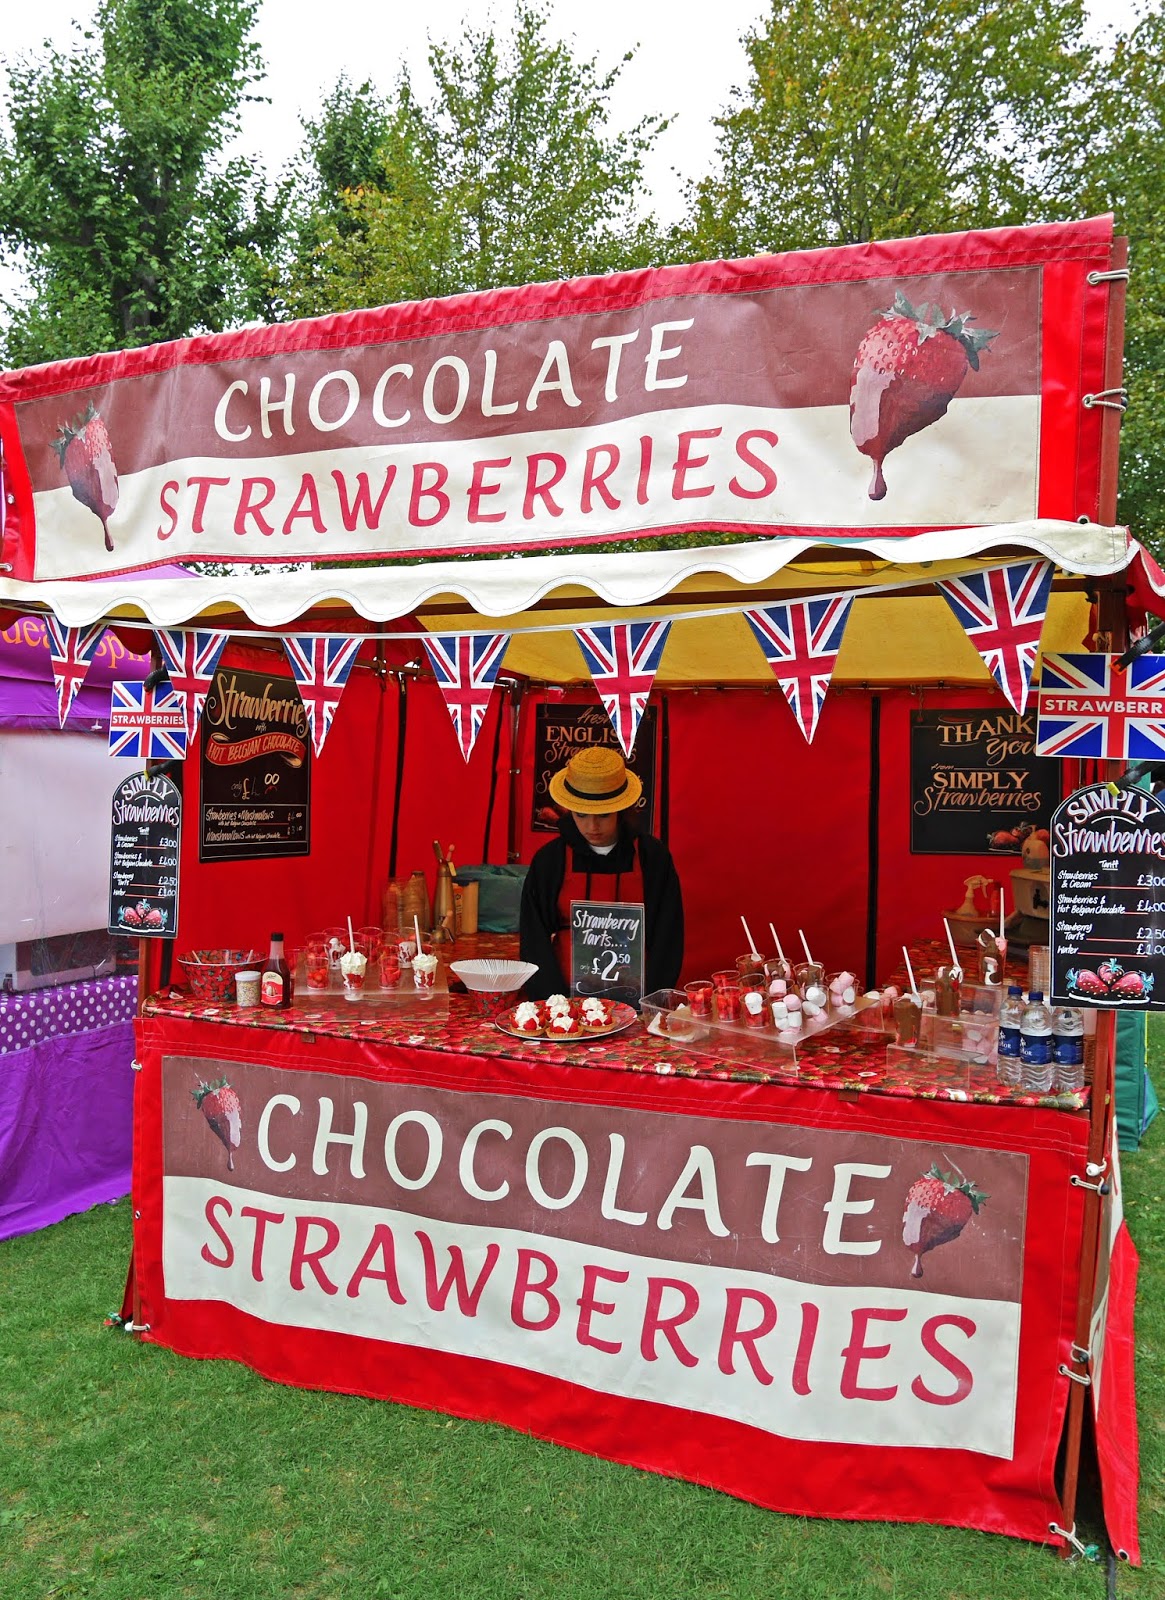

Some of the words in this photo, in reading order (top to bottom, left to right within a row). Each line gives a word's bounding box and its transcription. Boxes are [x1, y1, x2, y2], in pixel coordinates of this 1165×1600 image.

[213, 317, 695, 442] CHOCOLATE
[157, 426, 779, 541] STRAWBERRIES
[112, 715, 184, 725] STRAWBERRIES
[936, 714, 1035, 743] THANK
[207, 742, 227, 759] HOT
[227, 738, 261, 761] BELGIAN
[262, 734, 300, 751] CHOCOLATE
[121, 775, 175, 801] SIMPLY
[933, 771, 1030, 789] SIMPLY
[112, 798, 180, 826] Strawberries
[914, 786, 1042, 816] Strawberries
[1067, 788, 1160, 825] SIMPLY
[1057, 869, 1099, 881] Strawberries
[1061, 880, 1067, 889] &
[1069, 880, 1092, 889] Cream
[1057, 893, 1099, 905] Strawberries
[1057, 904, 1071, 914] Hot
[1071, 904, 1095, 917] Belgian
[1095, 903, 1126, 915] Chocolate
[573, 909, 640, 941] Strawberry
[1055, 920, 1093, 933] Strawberry
[1063, 931, 1085, 941] Tarts
[257, 1093, 893, 1256] CHOCOLATE
[200, 1195, 977, 1406] STRAWBERRIES
